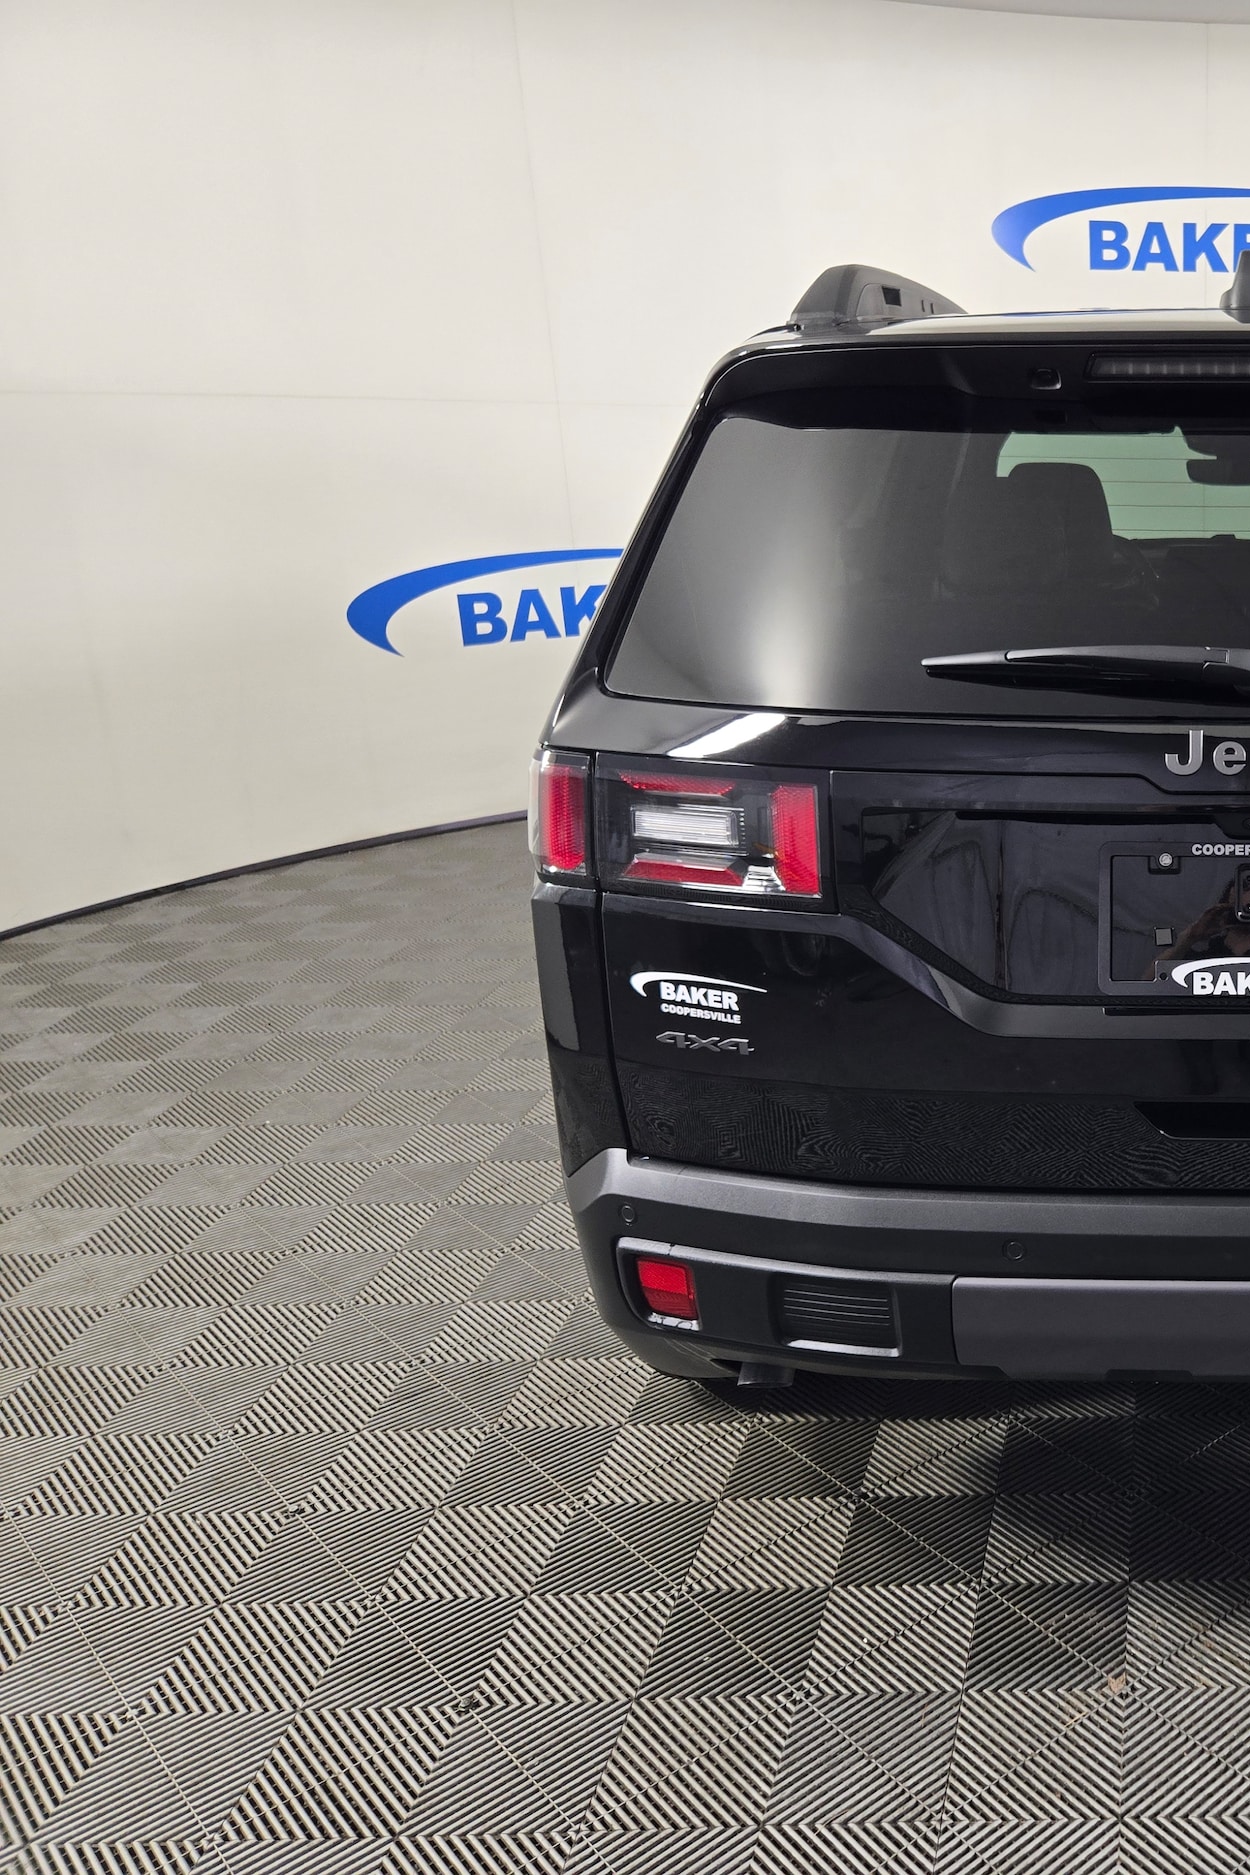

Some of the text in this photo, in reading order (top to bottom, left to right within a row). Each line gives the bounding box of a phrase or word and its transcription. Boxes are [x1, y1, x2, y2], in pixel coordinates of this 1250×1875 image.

[456, 584, 608, 647] BAK
[659, 981, 740, 1012] BAKER
[660, 1003, 742, 1025] COOPERSVILLE
